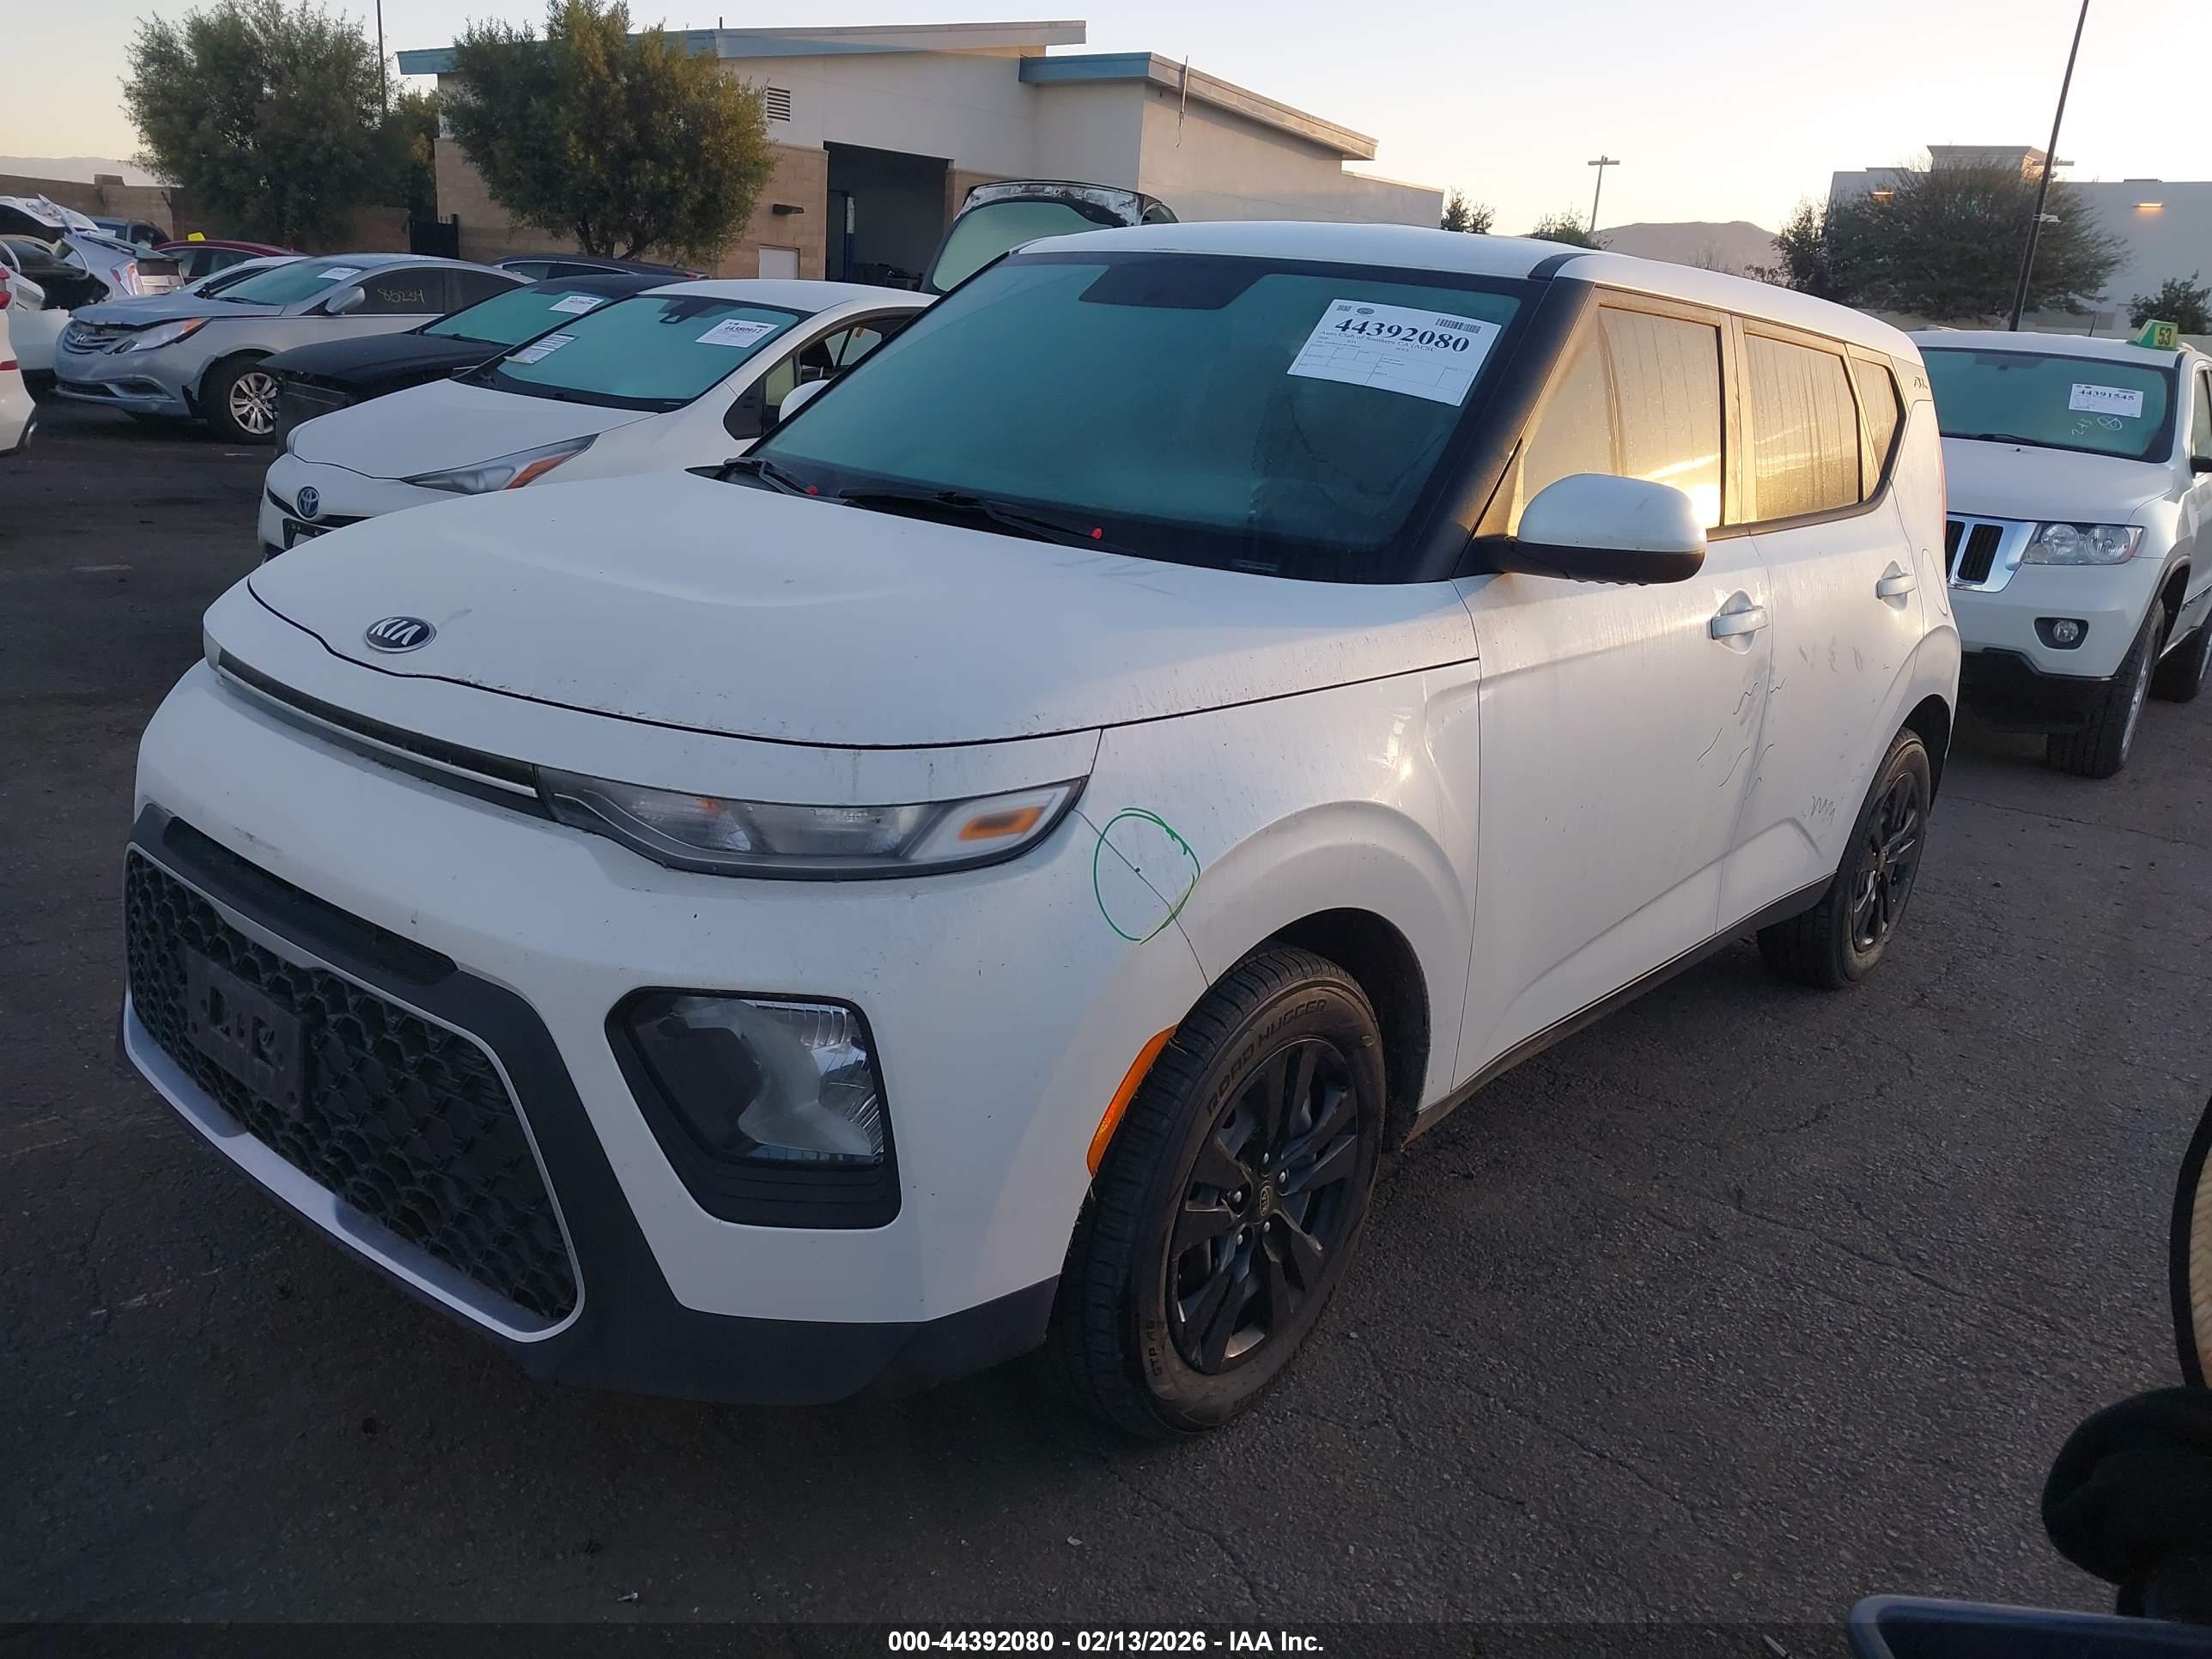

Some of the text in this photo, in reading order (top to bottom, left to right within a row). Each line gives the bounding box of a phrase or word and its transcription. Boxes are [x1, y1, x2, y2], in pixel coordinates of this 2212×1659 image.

[1335, 319, 1470, 352] 44392080
[1365, 336, 1395, 345] Southern
[2157, 326, 2172, 345] 53
[2079, 389, 2135, 401] 44391545
[1206, 998, 1328, 1116] ROAD HUGGER
